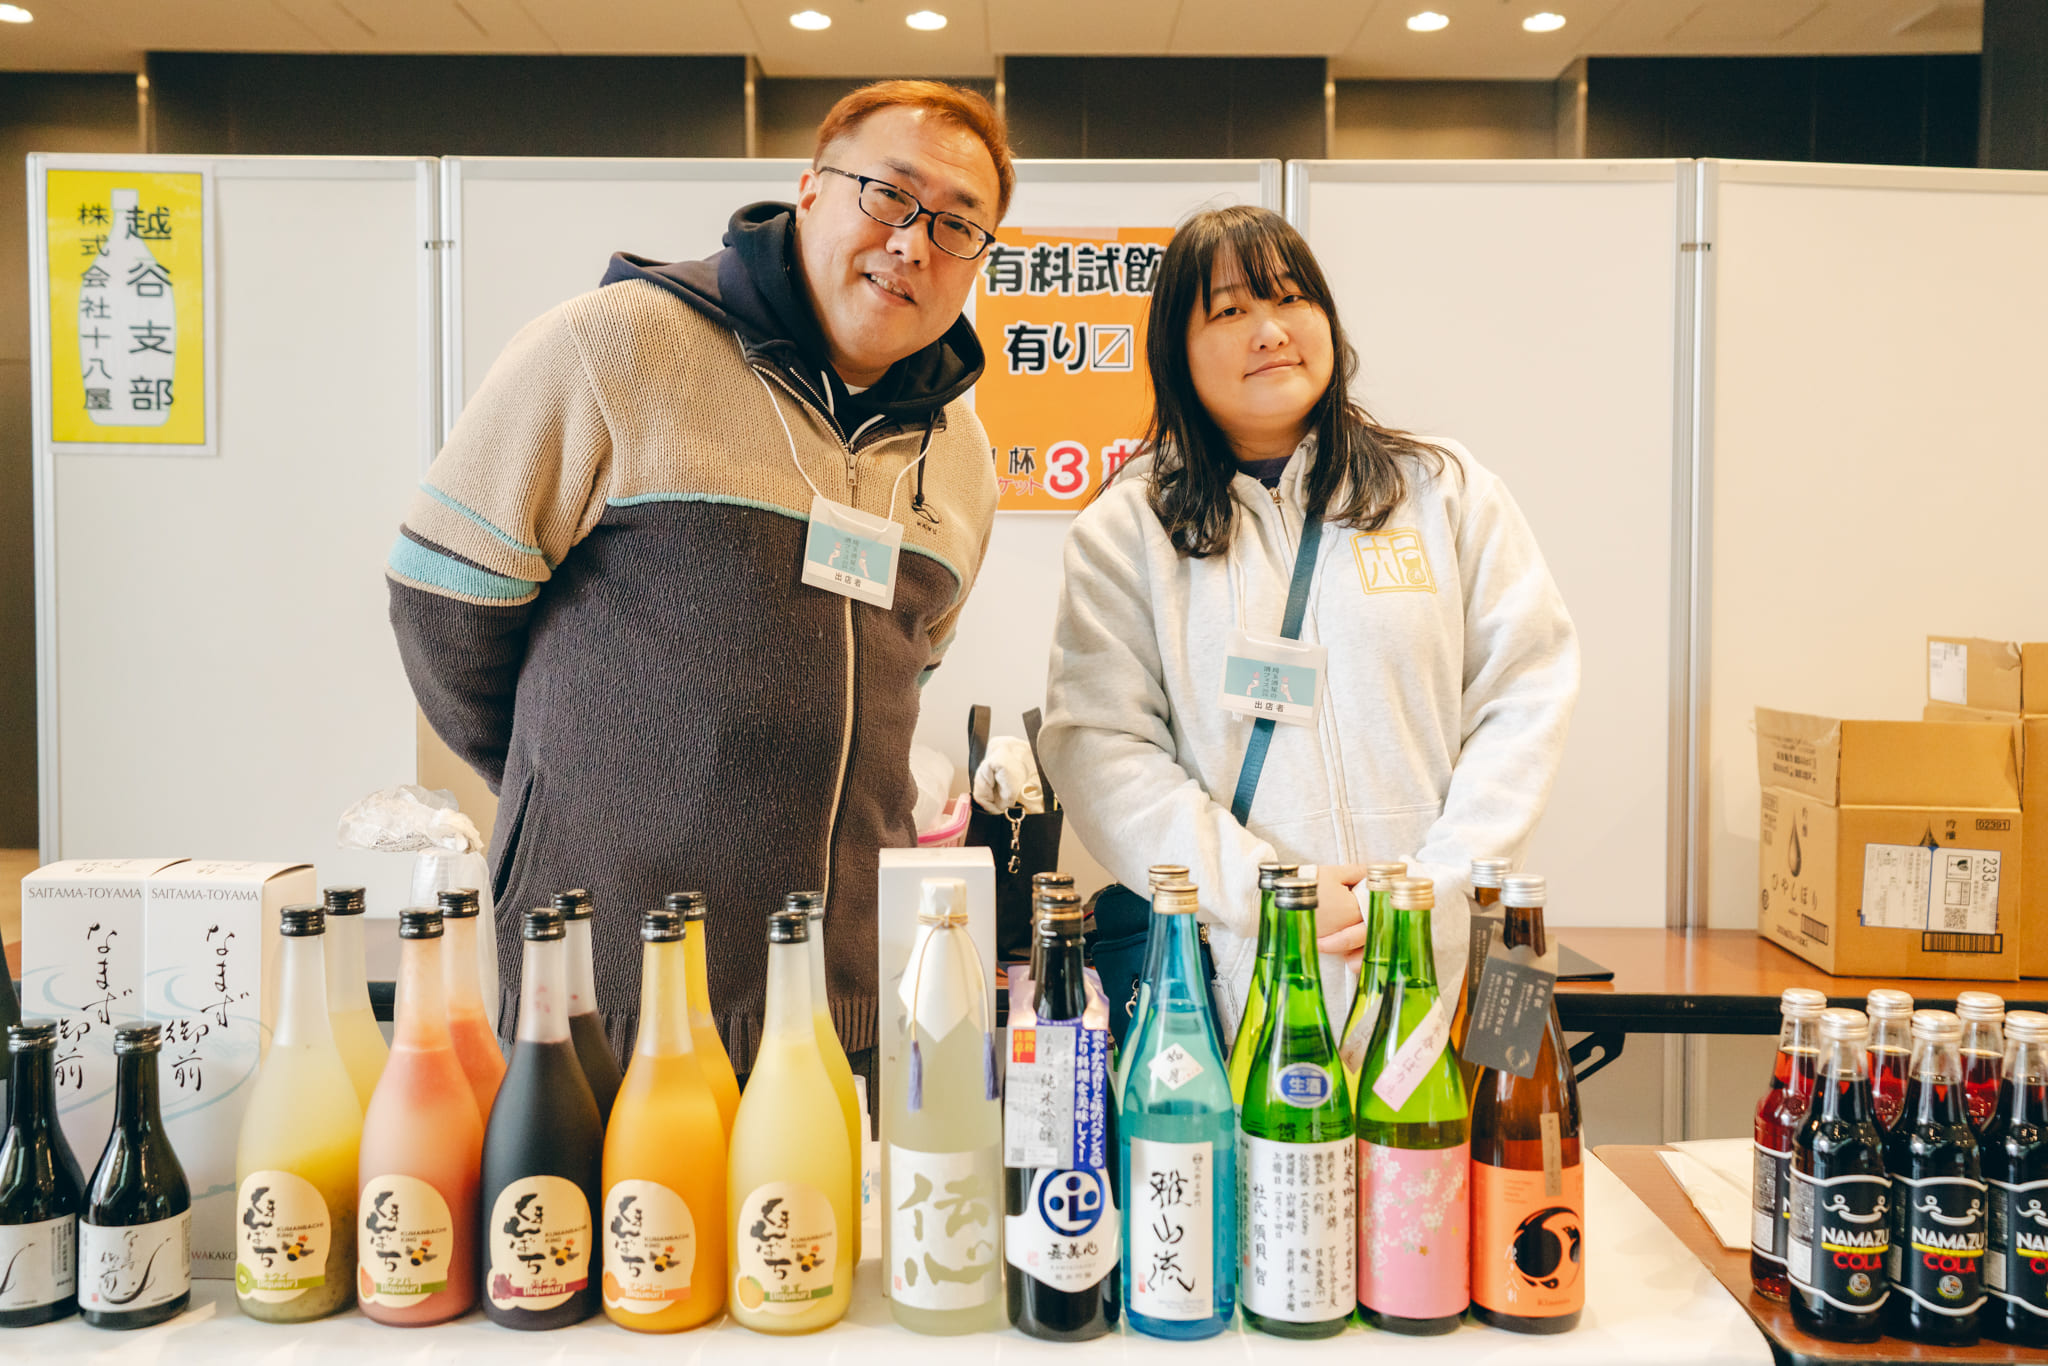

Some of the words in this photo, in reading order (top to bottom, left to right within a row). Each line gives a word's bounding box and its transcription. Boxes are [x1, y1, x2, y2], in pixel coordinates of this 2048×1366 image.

[987, 243, 1163, 294] 有料試飲
[77, 202, 113, 412] 株式会社十八屋
[125, 204, 174, 412] 越谷支部
[998, 477, 1046, 497] ケット
[834, 571, 862, 588] 出店者
[1254, 700, 1284, 713] 出店者
[1982, 857, 1998, 883] 233
[28, 886, 142, 899] SAITAMA-TOYAMA
[151, 888, 259, 901] SAITAMA-TOYAMA
[1289, 1077, 1321, 1095] 生酒
[1148, 1169, 1196, 1293] 雅山流
[1821, 1225, 1890, 1248] NAMAZU
[1911, 1225, 1985, 1250] NAMAZU
[1833, 1251, 1882, 1270] COLA
[1923, 1252, 1976, 1274] COLA
[2030, 1257, 2048, 1274] C
